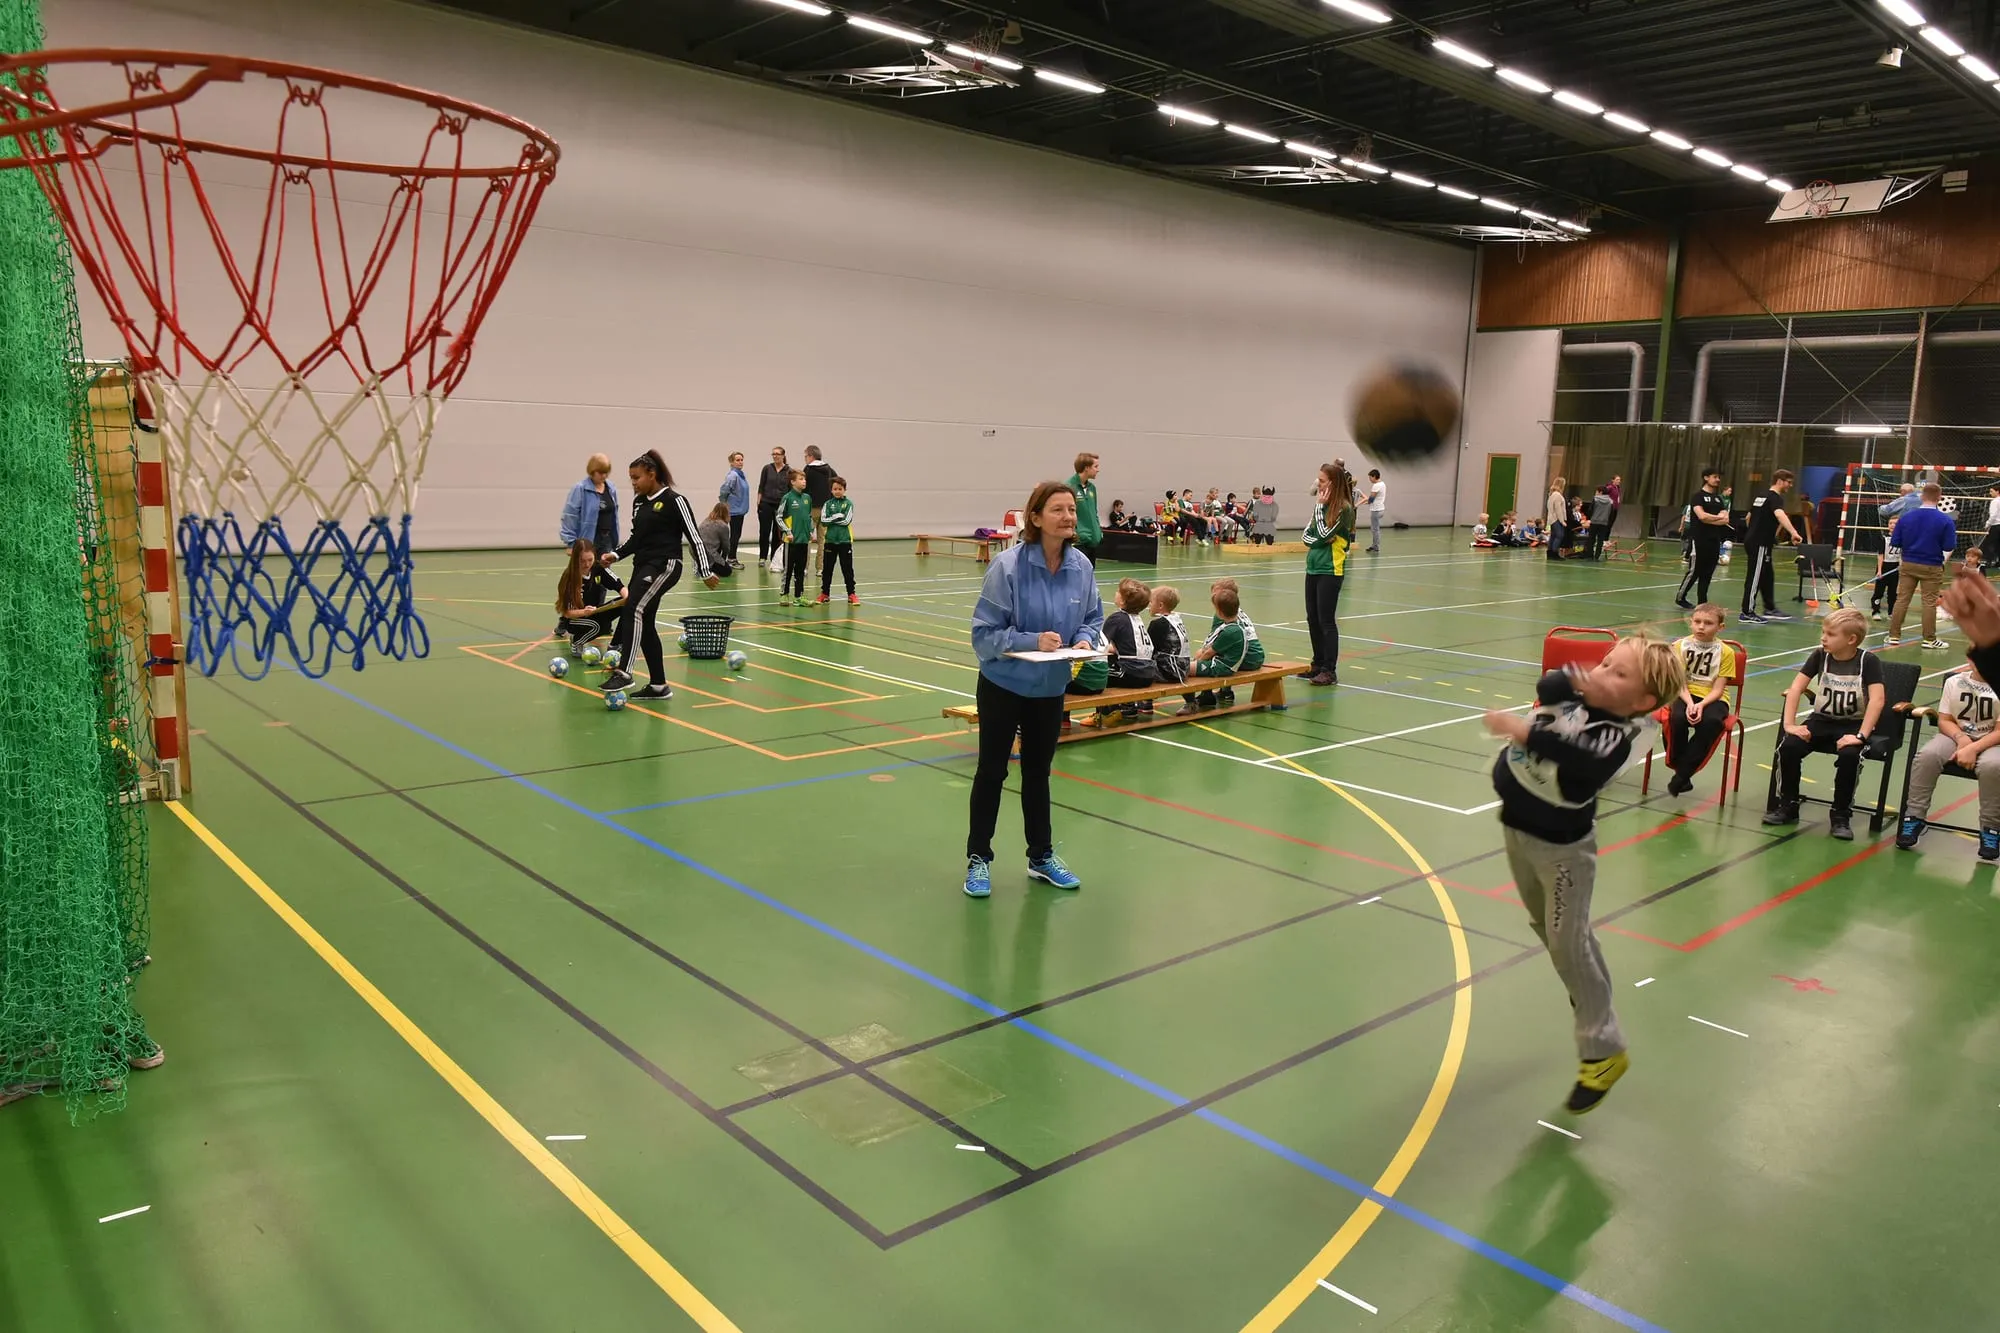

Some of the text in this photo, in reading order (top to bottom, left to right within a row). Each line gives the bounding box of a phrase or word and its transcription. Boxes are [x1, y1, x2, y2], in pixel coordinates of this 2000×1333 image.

[1686, 649, 1714, 677] 213
[1820, 687, 1858, 717] 209
[1957, 692, 1993, 723] 210
